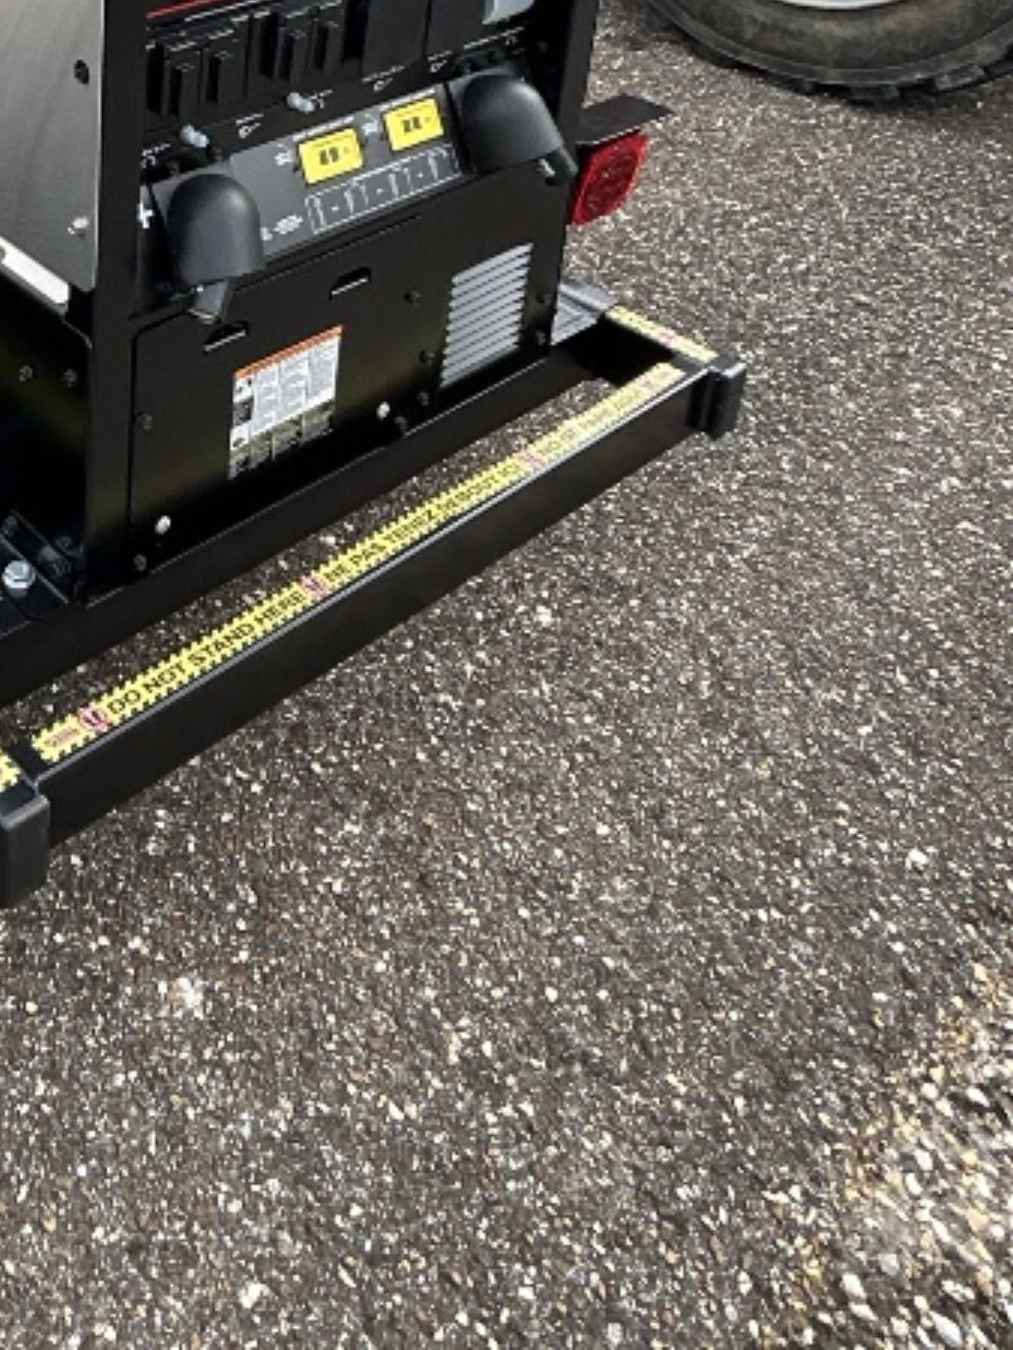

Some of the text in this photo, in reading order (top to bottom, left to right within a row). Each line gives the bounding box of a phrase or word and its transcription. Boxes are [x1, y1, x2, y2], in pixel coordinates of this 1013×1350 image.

[106, 688, 143, 717] DO
[143, 661, 186, 695] NOT
[187, 619, 256, 668] STAND
[252, 589, 307, 628] HERE
[349, 539, 386, 568] PAS
